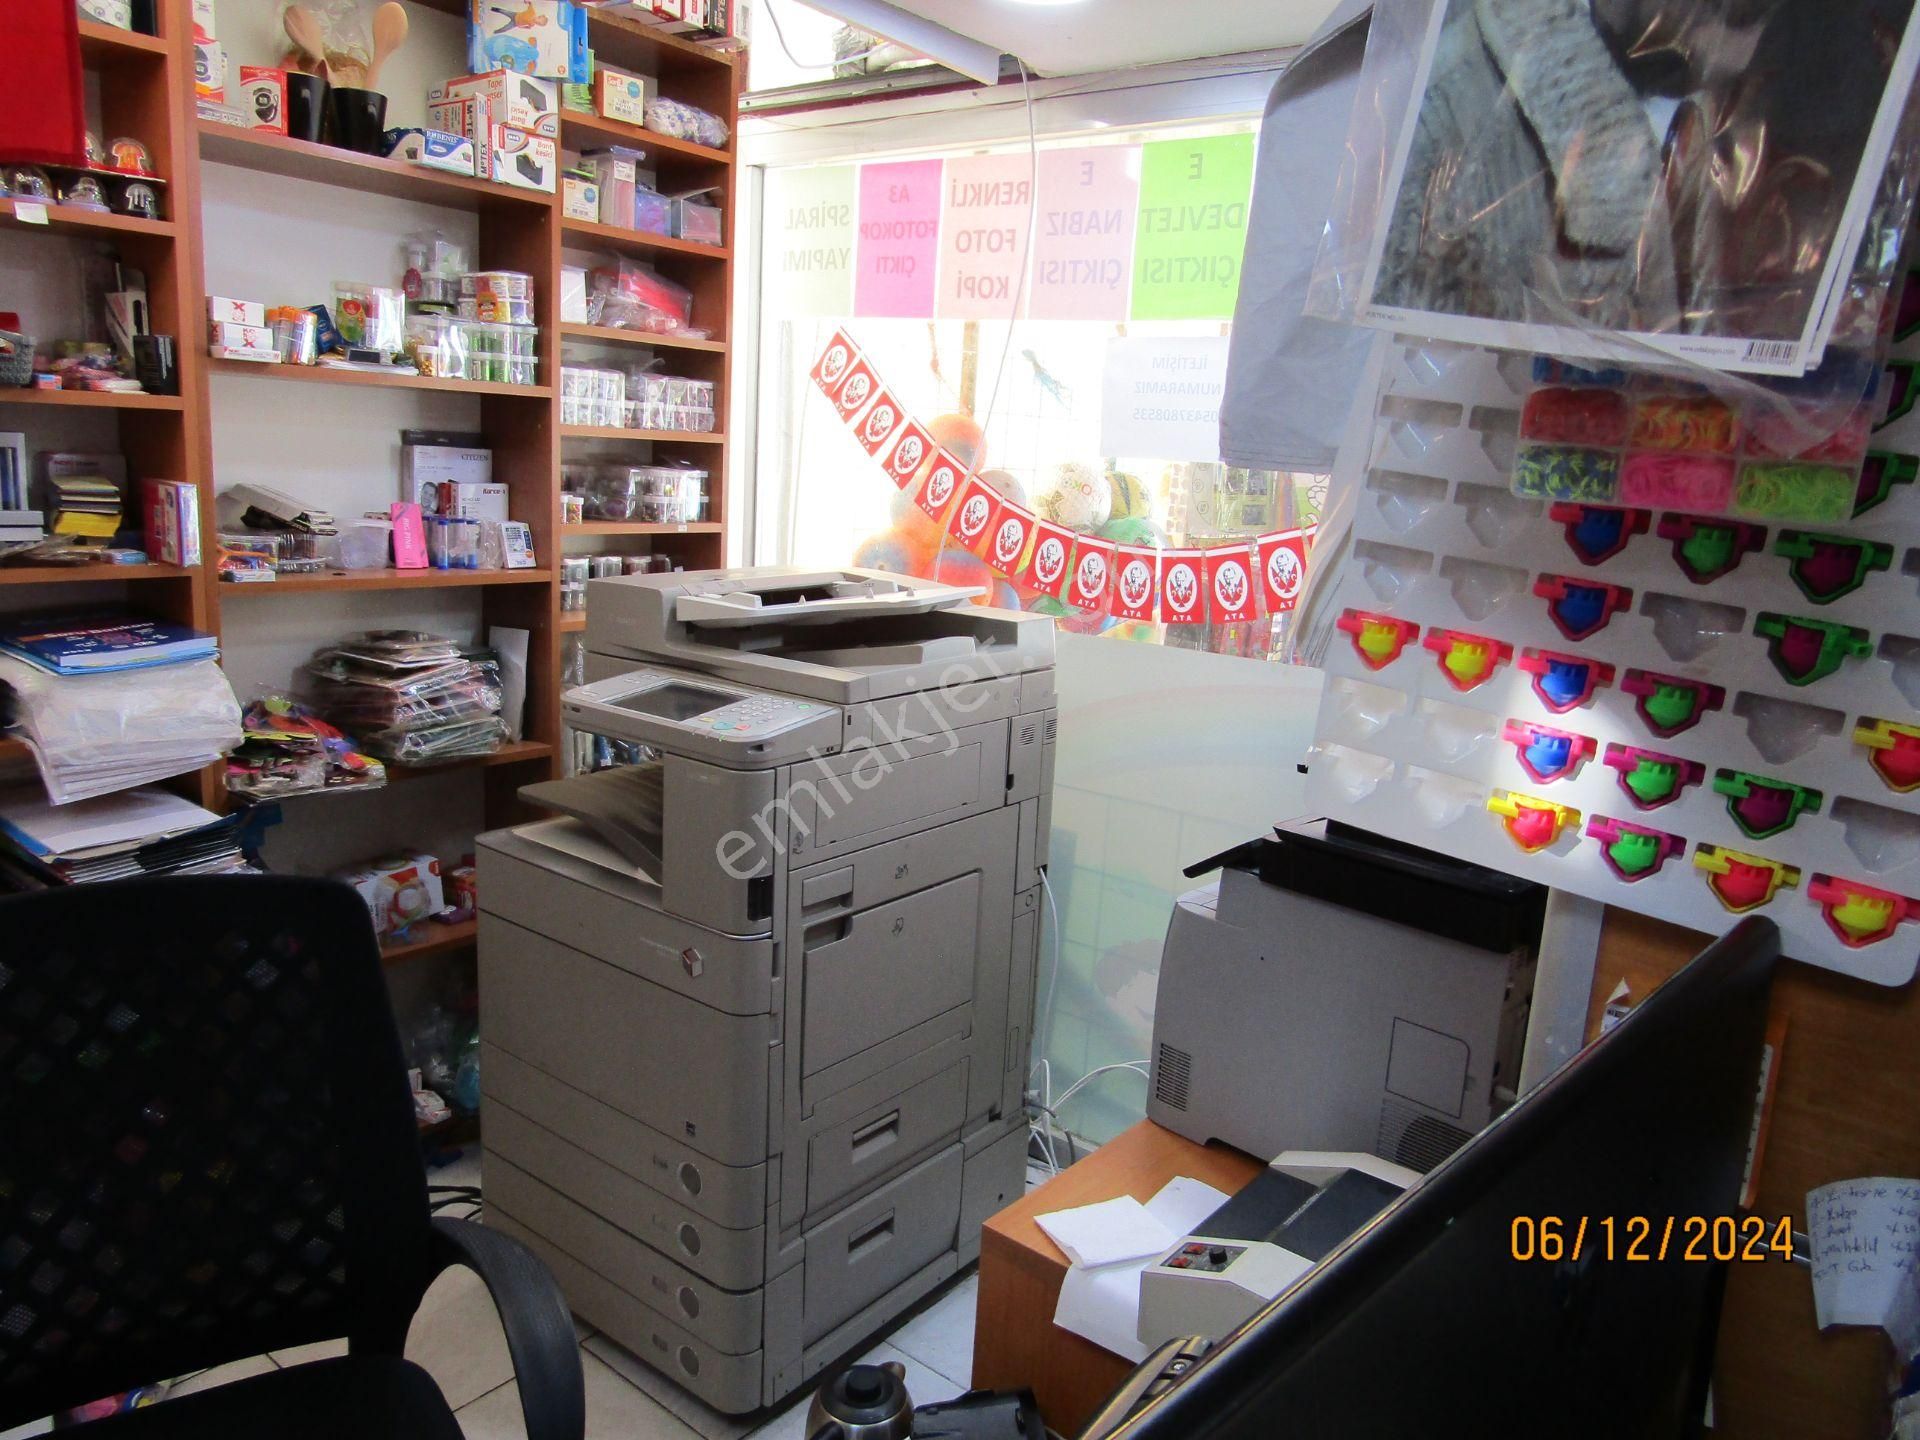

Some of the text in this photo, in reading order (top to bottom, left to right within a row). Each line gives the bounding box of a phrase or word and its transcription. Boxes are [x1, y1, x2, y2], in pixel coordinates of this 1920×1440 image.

[537, 141, 553, 150] Bant
[921, 502, 934, 516] ATA
[955, 531, 969, 546] ATA
[992, 559, 1007, 572] ATA
[1033, 581, 1051, 593] ATA
[1077, 599, 1095, 609] ATA
[1279, 600, 1295, 609] AT
[1122, 609, 1142, 618] ATA
[1171, 614, 1193, 622] ATA
[1224, 613, 1245, 621] ATA
